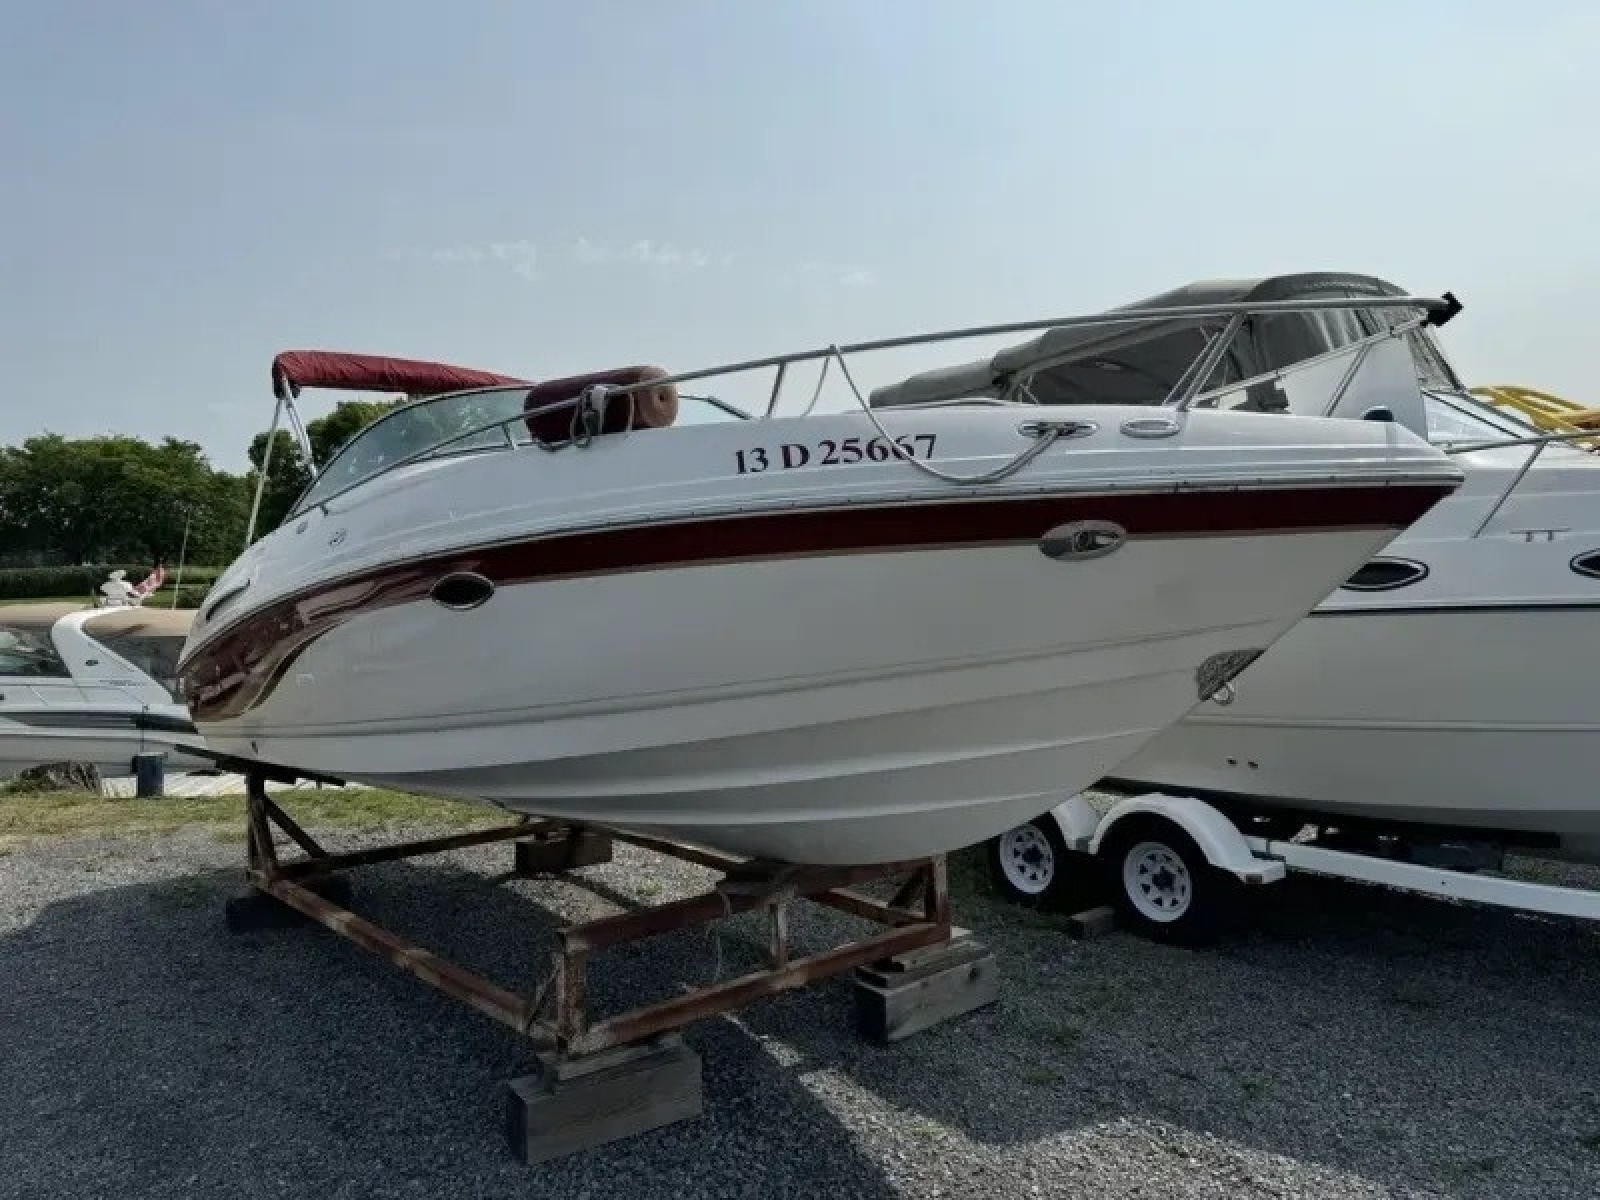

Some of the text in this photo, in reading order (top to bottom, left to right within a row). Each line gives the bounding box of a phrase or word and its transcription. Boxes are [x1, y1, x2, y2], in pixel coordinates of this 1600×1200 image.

[735, 433, 937, 474] 13 D 25667
